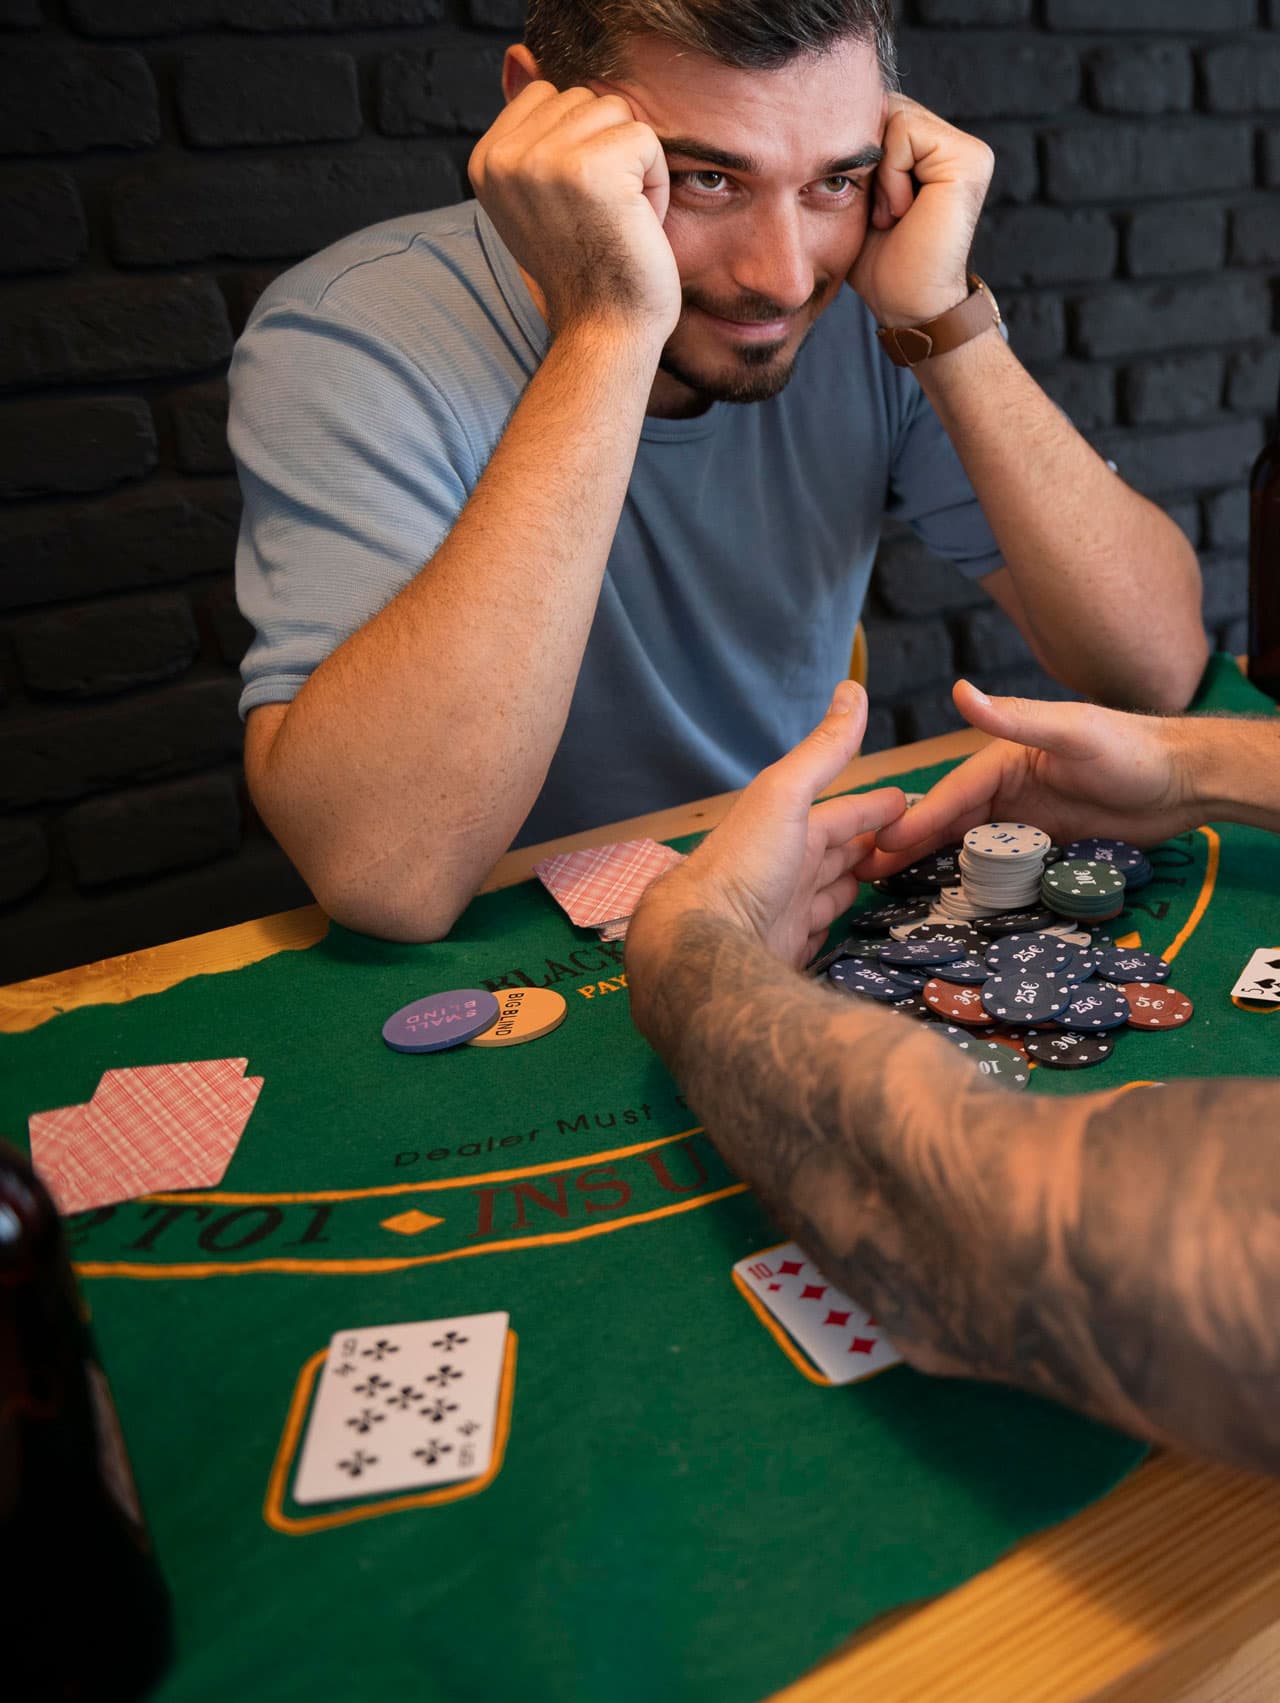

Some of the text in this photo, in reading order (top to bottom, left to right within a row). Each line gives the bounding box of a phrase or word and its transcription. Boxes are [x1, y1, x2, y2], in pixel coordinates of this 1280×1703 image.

[1073, 869, 1097, 885] 10€
[1012, 944, 1045, 963] 25€
[1114, 958, 1147, 971] 25€
[576, 974, 630, 1000] PAY
[855, 968, 891, 984] 25€
[1014, 981, 1040, 1005] 25€
[406, 1000, 476, 1025] BLIND
[495, 992, 525, 1037] BIG BLIND
[1069, 996, 1103, 1014] 25€
[404, 1009, 477, 1033] SMALL
[394, 1103, 652, 1168] Dealer Must
[746, 1261, 775, 1281] 10
